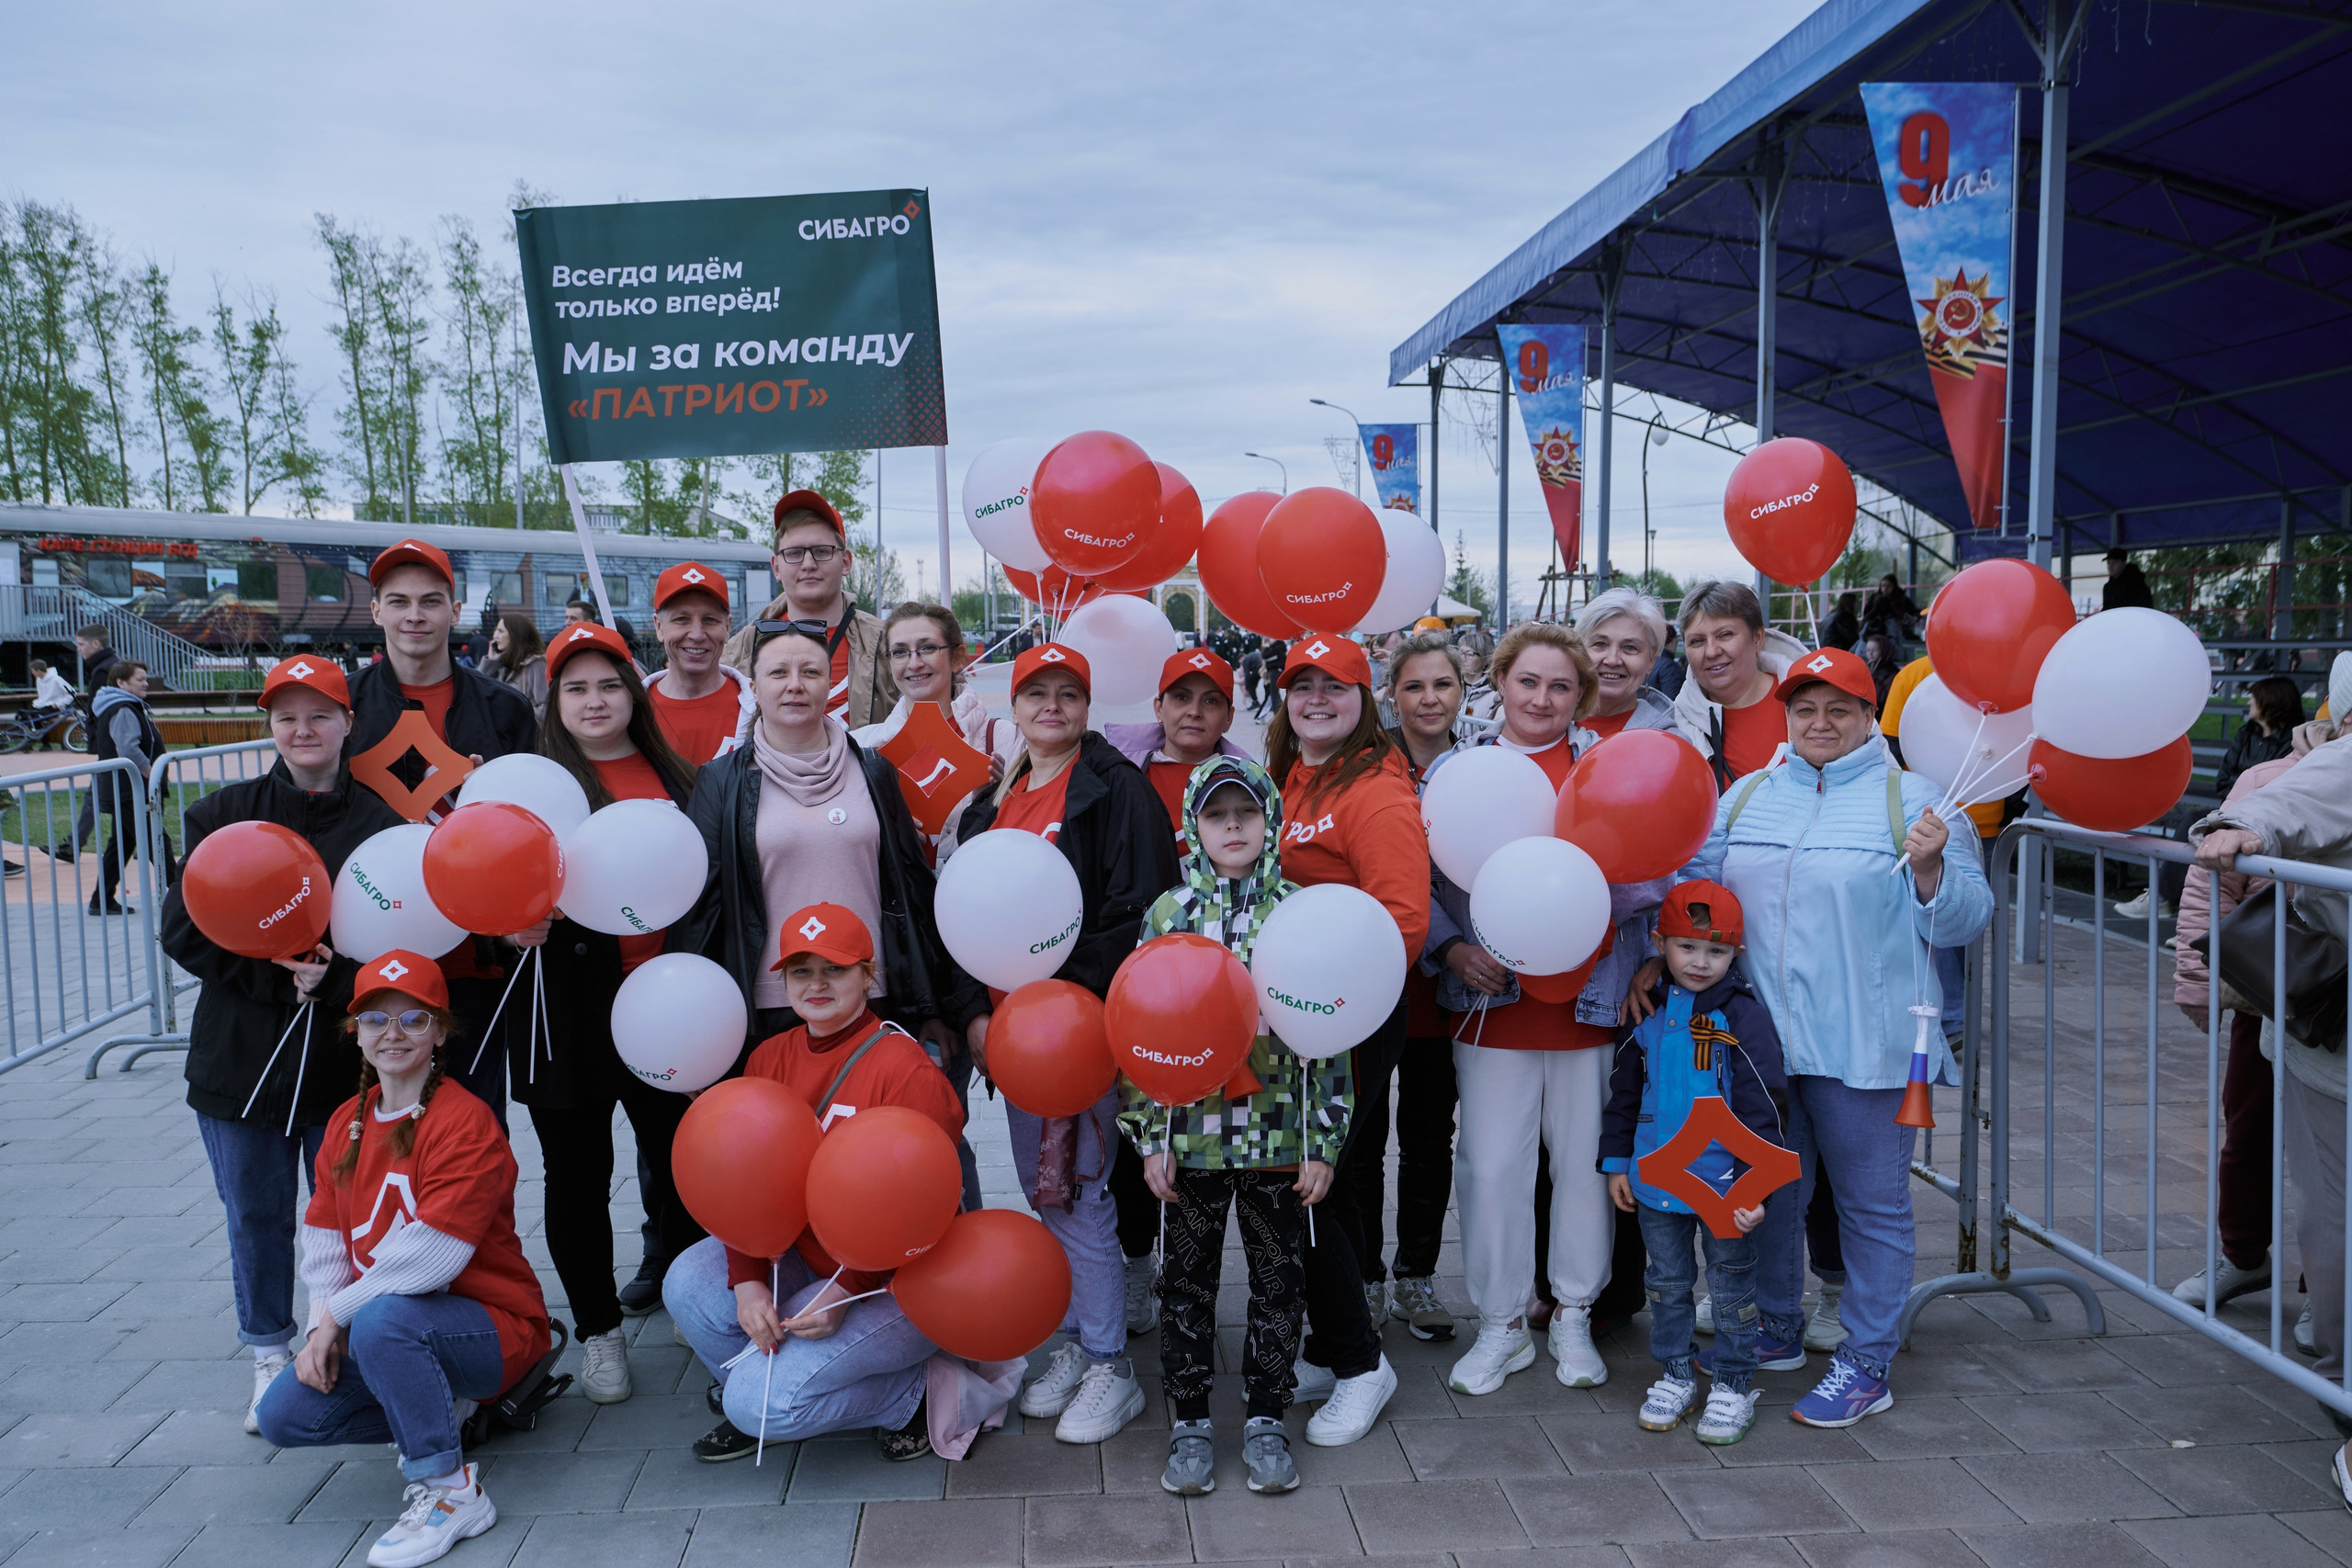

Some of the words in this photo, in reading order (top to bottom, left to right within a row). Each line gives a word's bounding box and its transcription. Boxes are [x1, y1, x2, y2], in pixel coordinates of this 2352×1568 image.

[1899, 112, 1950, 209] 9
[798, 214, 910, 242] СИБАГРО
[552, 265, 657, 288] Всегда
[666, 256, 743, 285] идём
[555, 294, 658, 320] только
[666, 287, 781, 317] вперёд!
[562, 341, 637, 375] Мы
[650, 343, 700, 371] за
[714, 332, 914, 367] команду
[1520, 341, 1548, 393] 9
[567, 378, 829, 421] «ПАТРИОТ»
[1373, 434, 1394, 470] 9
[975, 495, 1024, 519] СИБАГРО
[1750, 491, 1814, 520] СИБАГРО
[39, 537, 87, 553] КАФЕ
[89, 540, 164, 556] СТАНЦИЯ
[1064, 528, 1127, 548] СИБАГРО
[1286, 589, 1347, 604] СИБАГРО
[349, 862, 391, 910] СИБАГРО
[258, 886, 311, 930] СИБАГРО
[1029, 916, 1080, 954] СИБАГРО
[1267, 987, 1336, 1015] СИБАГРО
[1132, 1044, 1204, 1066] СИБАГРО
[1170, 1217, 1206, 1271] AIR
[1248, 1244, 1285, 1301] AIR
